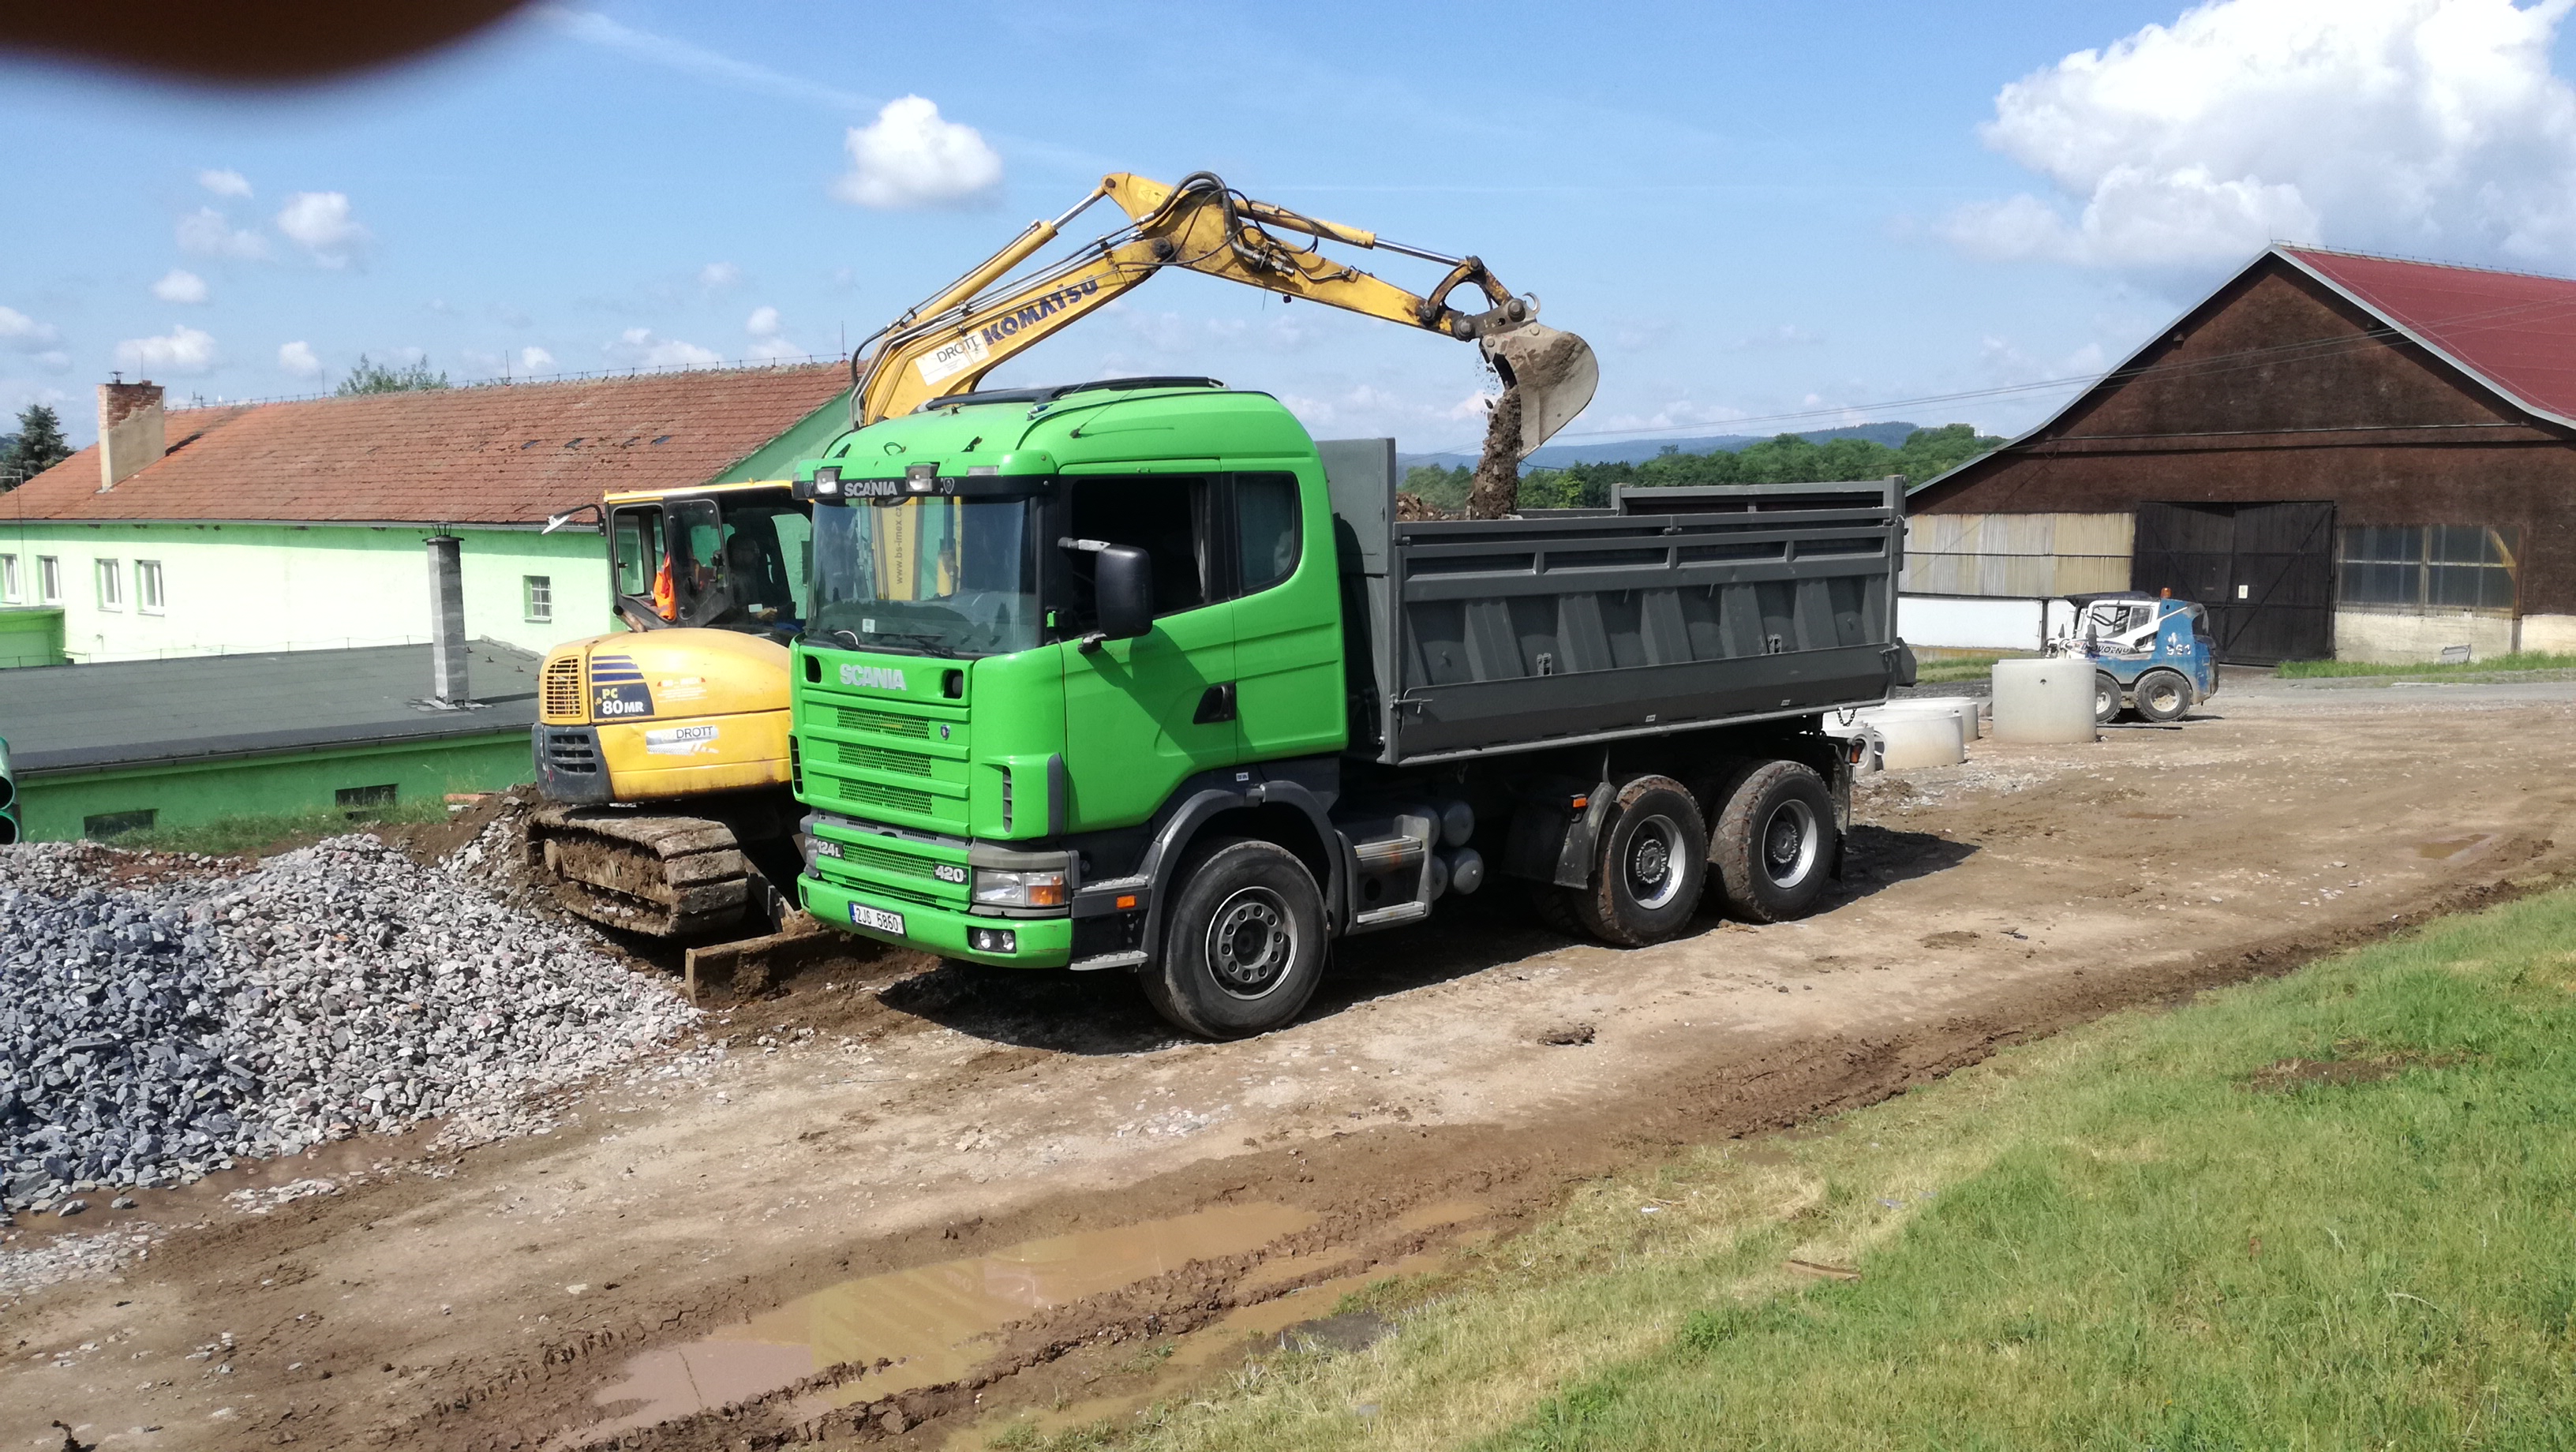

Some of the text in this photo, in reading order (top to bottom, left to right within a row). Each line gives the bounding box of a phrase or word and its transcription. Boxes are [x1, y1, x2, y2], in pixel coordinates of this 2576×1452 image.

[981, 275, 1098, 346] KOMATSU
[937, 335, 978, 363] DROTT
[844, 481, 898, 497] SCANIA
[840, 664, 907, 691] SCANIA
[602, 687, 618, 700] PC
[676, 726, 713, 739] DROTT
[935, 865, 964, 882] 420
[877, 912, 898, 931] 5860
